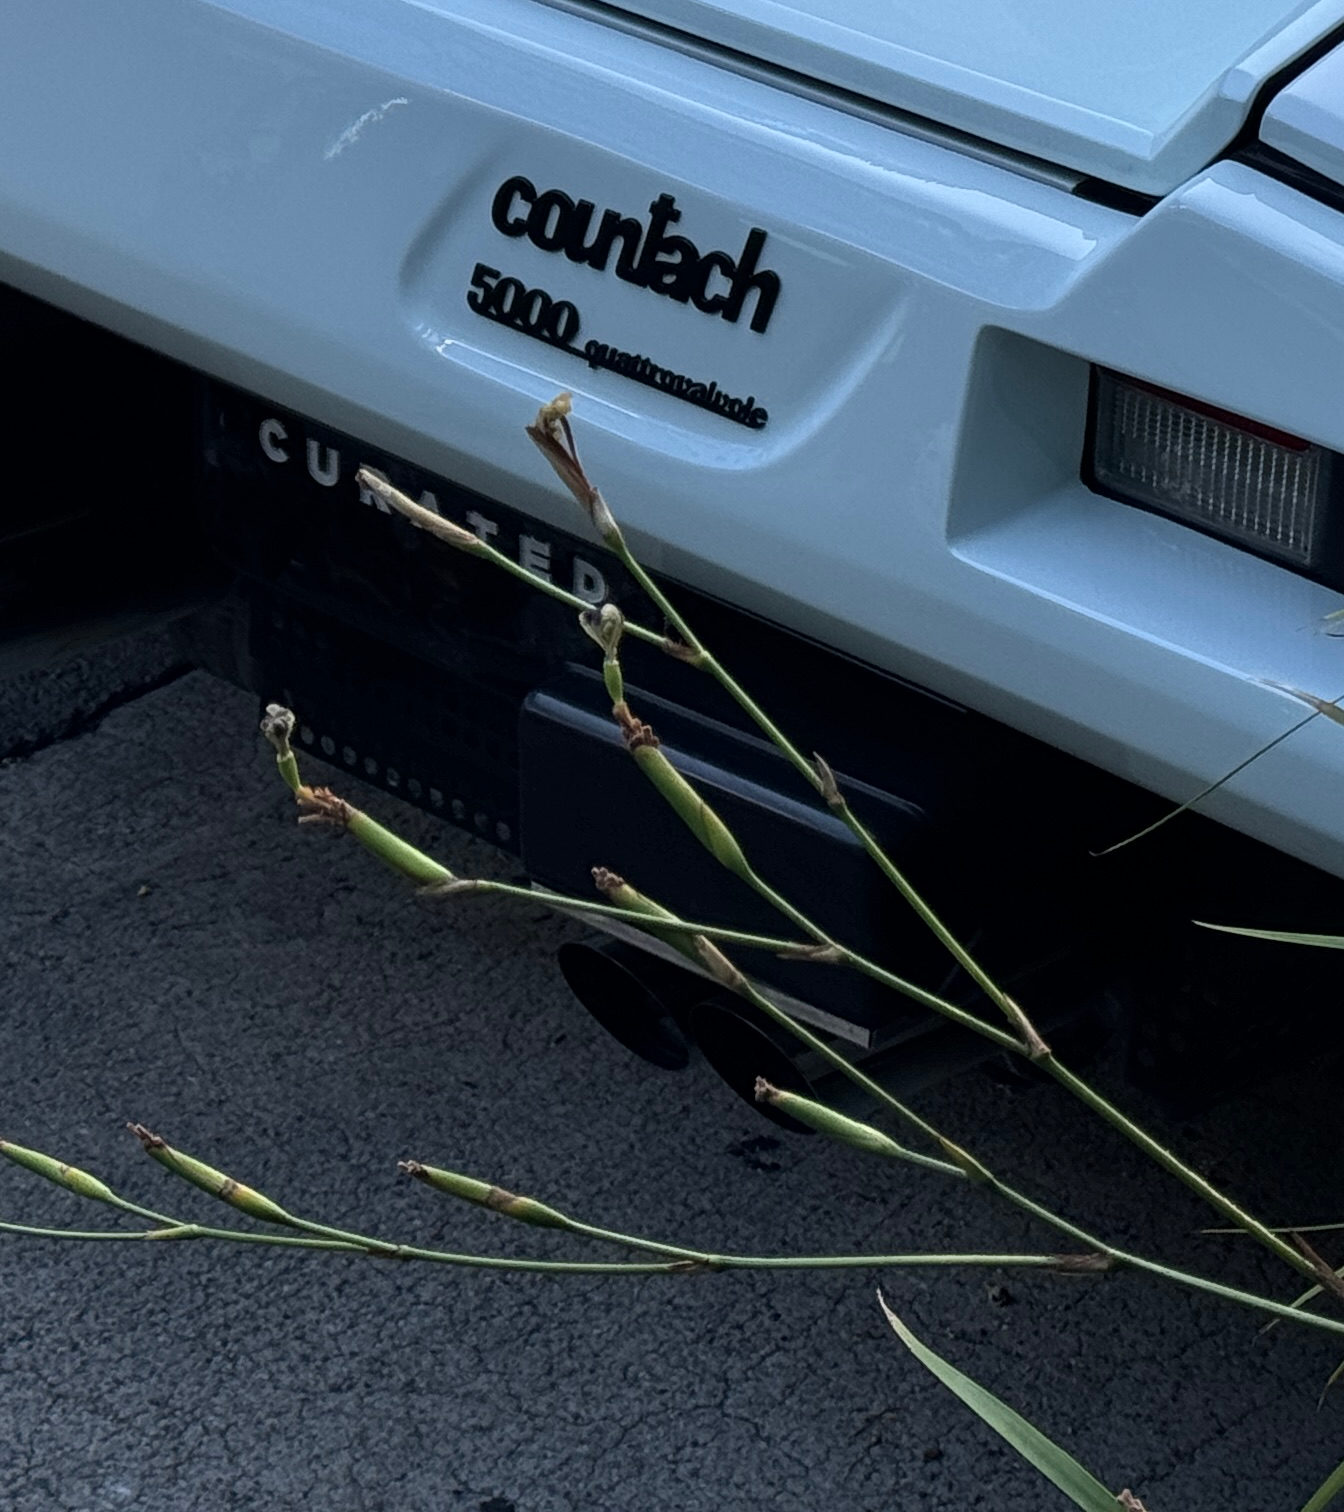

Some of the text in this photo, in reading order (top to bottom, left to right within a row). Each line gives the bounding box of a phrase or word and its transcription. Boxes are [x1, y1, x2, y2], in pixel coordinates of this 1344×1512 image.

[491, 175, 781, 334] countach
[467, 262, 769, 430] 5000 quattrovalvole
